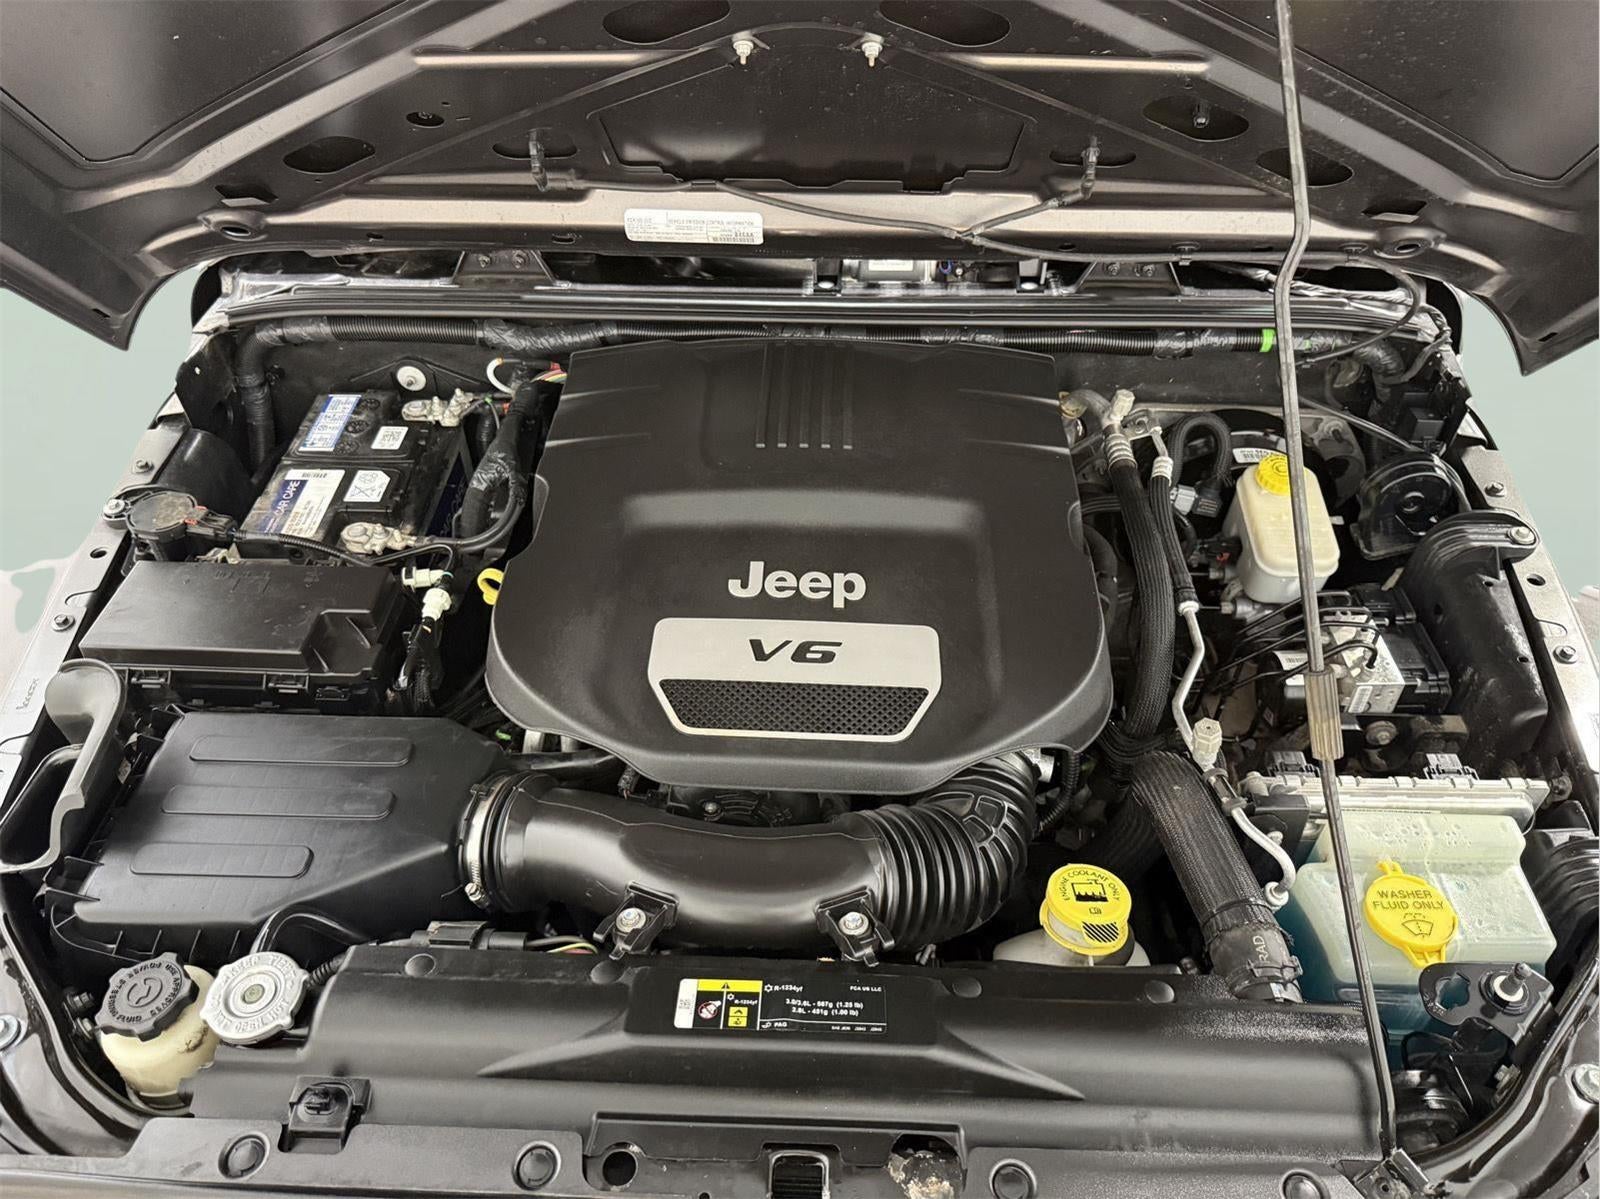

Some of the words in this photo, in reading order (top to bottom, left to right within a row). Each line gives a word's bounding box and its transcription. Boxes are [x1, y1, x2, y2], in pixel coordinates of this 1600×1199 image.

[728, 560, 867, 609] Jeep
[749, 638, 843, 664] V6
[1067, 869, 1109, 882] COOLANT
[1108, 882, 1121, 901] ONLY
[1376, 889, 1433, 899] WASHER
[1372, 900, 1410, 910] FLUID
[1412, 900, 1444, 910] ONLY
[1252, 935, 1269, 961] RAD
